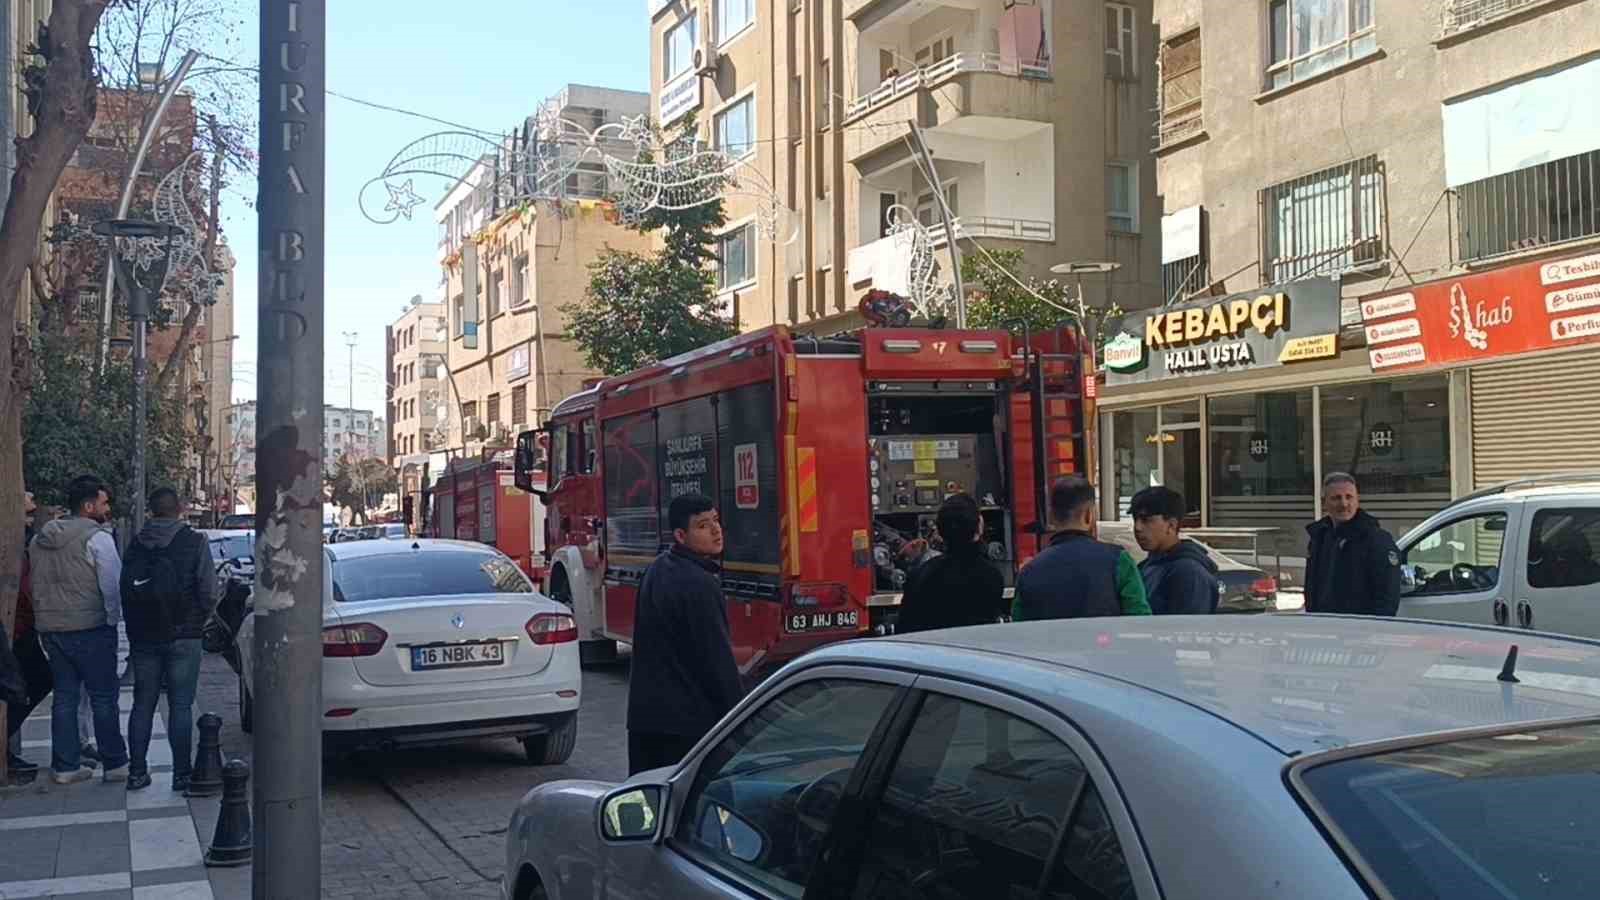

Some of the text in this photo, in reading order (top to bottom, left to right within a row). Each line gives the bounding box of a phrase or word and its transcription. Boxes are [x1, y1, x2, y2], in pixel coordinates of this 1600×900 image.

[1146, 293, 1284, 346] KEBAPÇI
[1210, 341, 1251, 364] USTA
[793, 615, 807, 629] 63
[837, 611, 857, 626] 846
[421, 649, 437, 665] 16
[442, 646, 475, 663] NBK
[481, 645, 499, 659] 43
